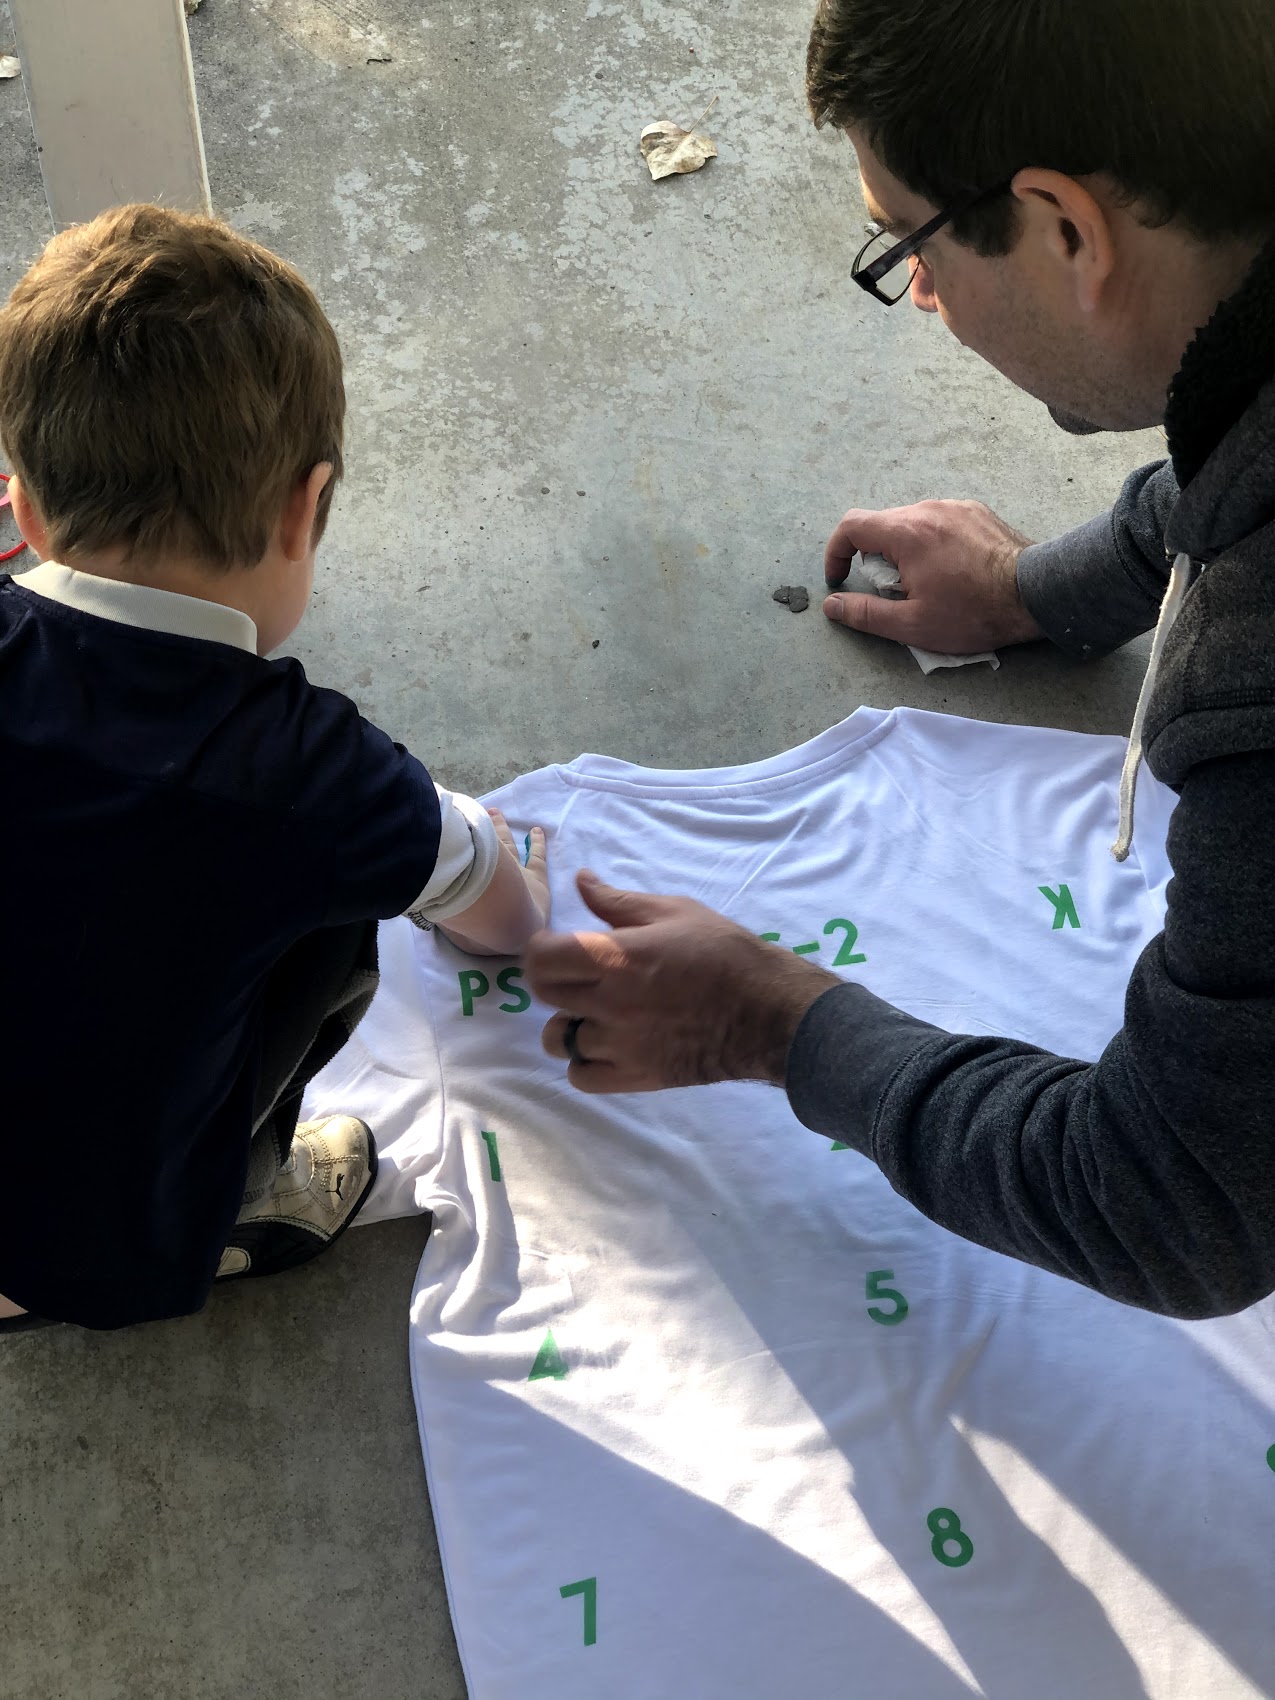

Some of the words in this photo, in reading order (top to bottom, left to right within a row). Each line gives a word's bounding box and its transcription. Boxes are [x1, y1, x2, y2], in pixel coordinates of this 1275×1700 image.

[481, 1130, 502, 1182] 1
[865, 1269, 909, 1326] 5
[927, 1507, 974, 1568] 8
[559, 1576, 597, 1647] 7
